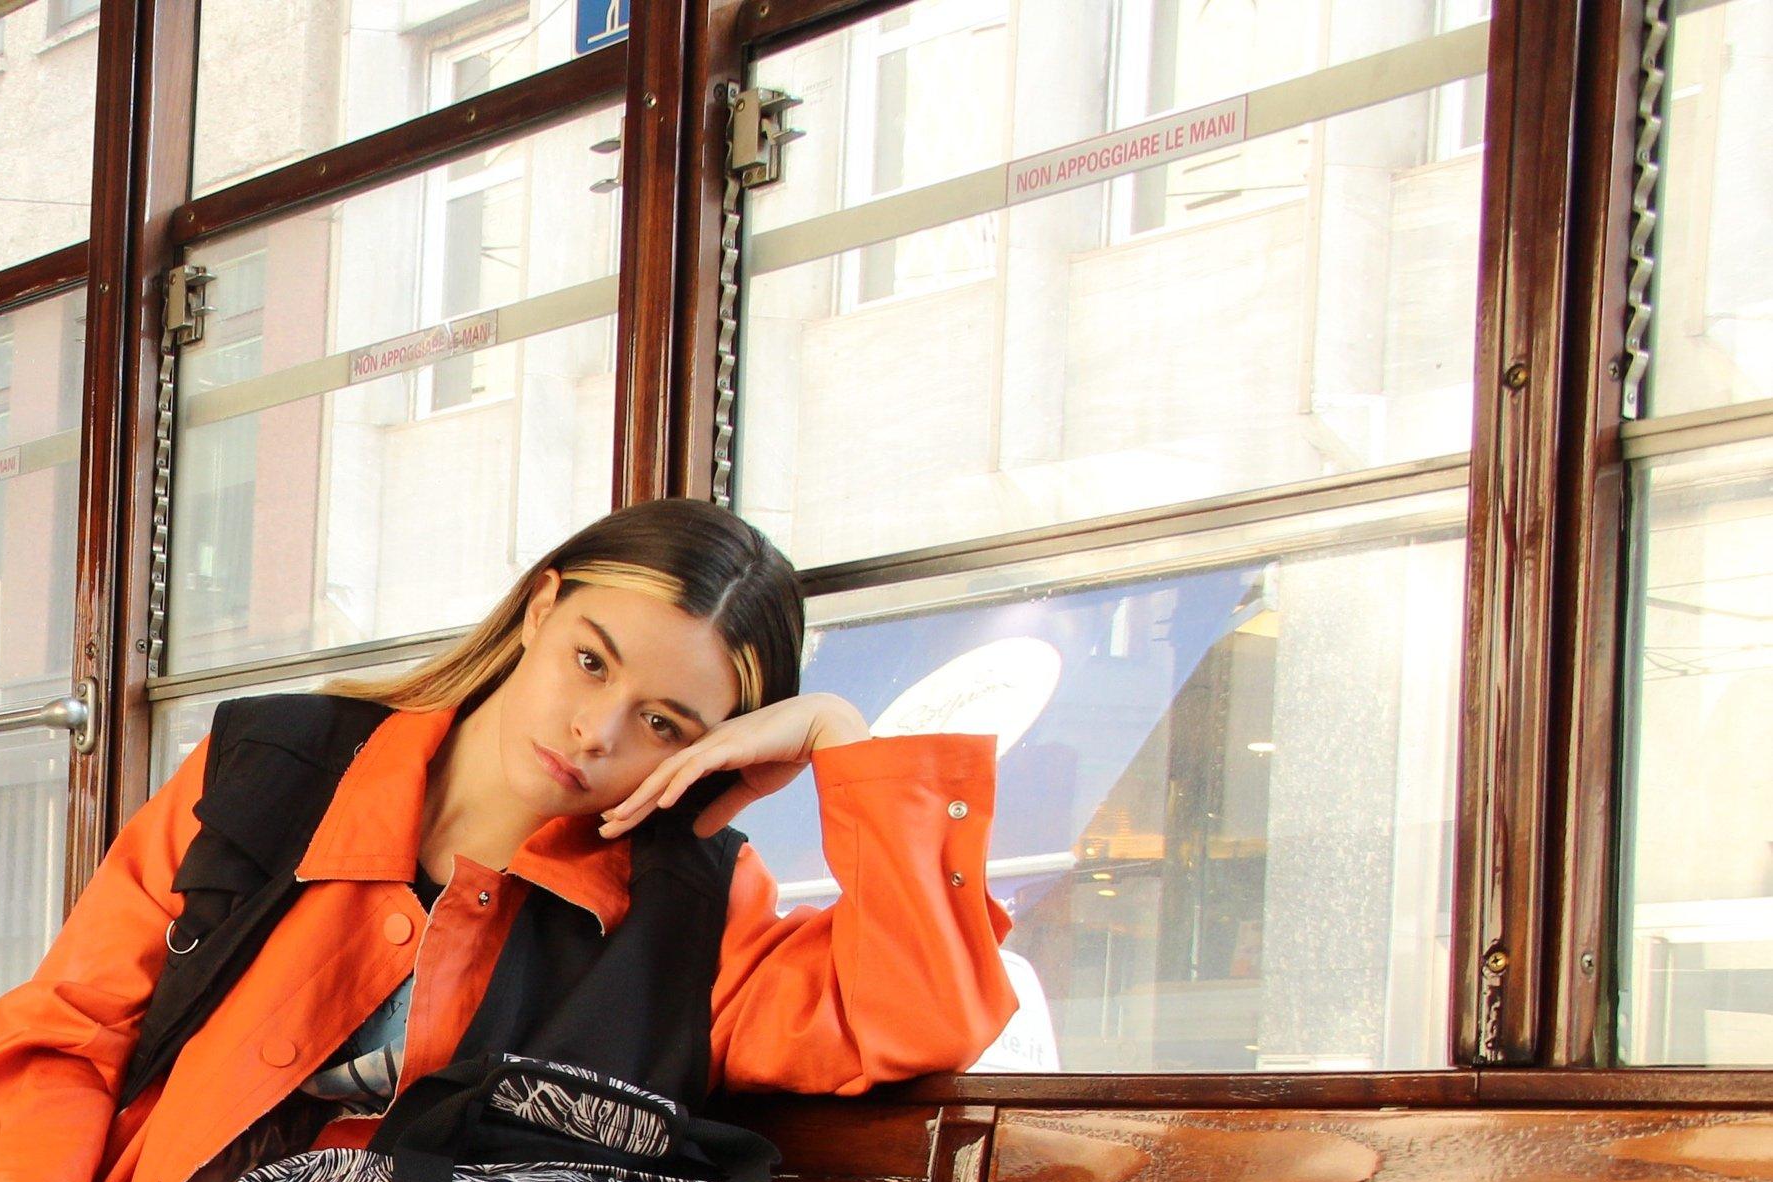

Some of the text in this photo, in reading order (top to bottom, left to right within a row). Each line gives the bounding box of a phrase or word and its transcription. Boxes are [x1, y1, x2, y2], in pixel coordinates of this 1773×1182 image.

[1016, 111, 1236, 194] NON APPOGGIARE LE MANI
[354, 355, 378, 377] NON
[462, 322, 492, 347] MANI
